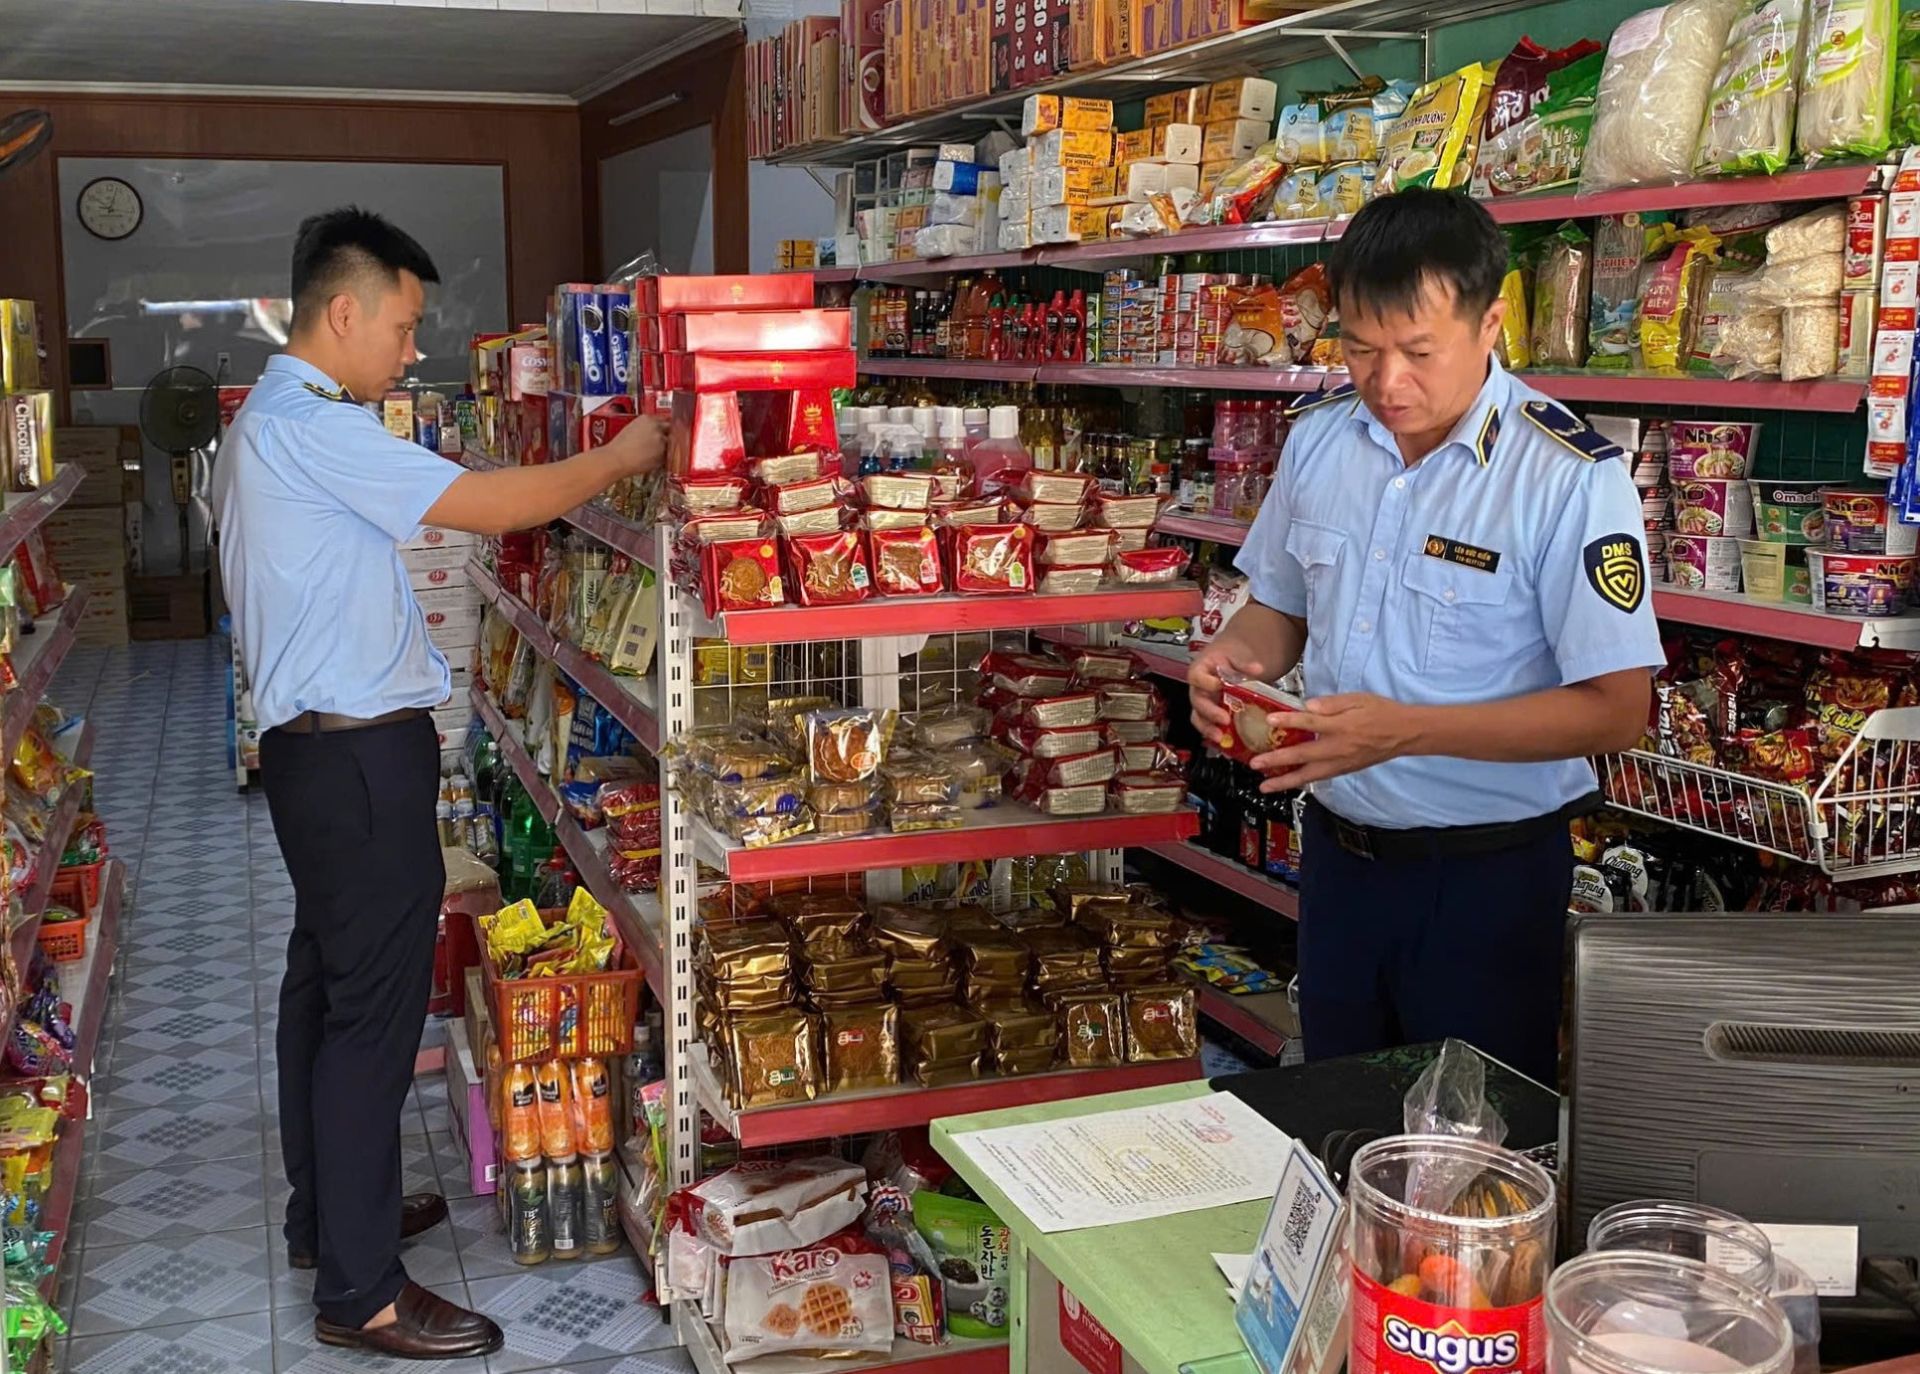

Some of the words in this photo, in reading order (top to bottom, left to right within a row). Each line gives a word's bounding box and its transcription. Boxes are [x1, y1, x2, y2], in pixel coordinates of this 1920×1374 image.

[1014, 3, 1026, 33] 30
[1014, 54, 1026, 70] 3
[582, 334, 600, 382] OREO
[611, 335, 628, 382] OREO
[14, 403, 31, 466] ChocoPie
[1773, 489, 1821, 503] Omach
[1601, 542, 1632, 559] DMS
[771, 1247, 841, 1281] Karo
[980, 1225, 998, 1280] 돌자반
[1081, 1314, 1115, 1351] money
[1386, 1319, 1517, 1373] sugus
